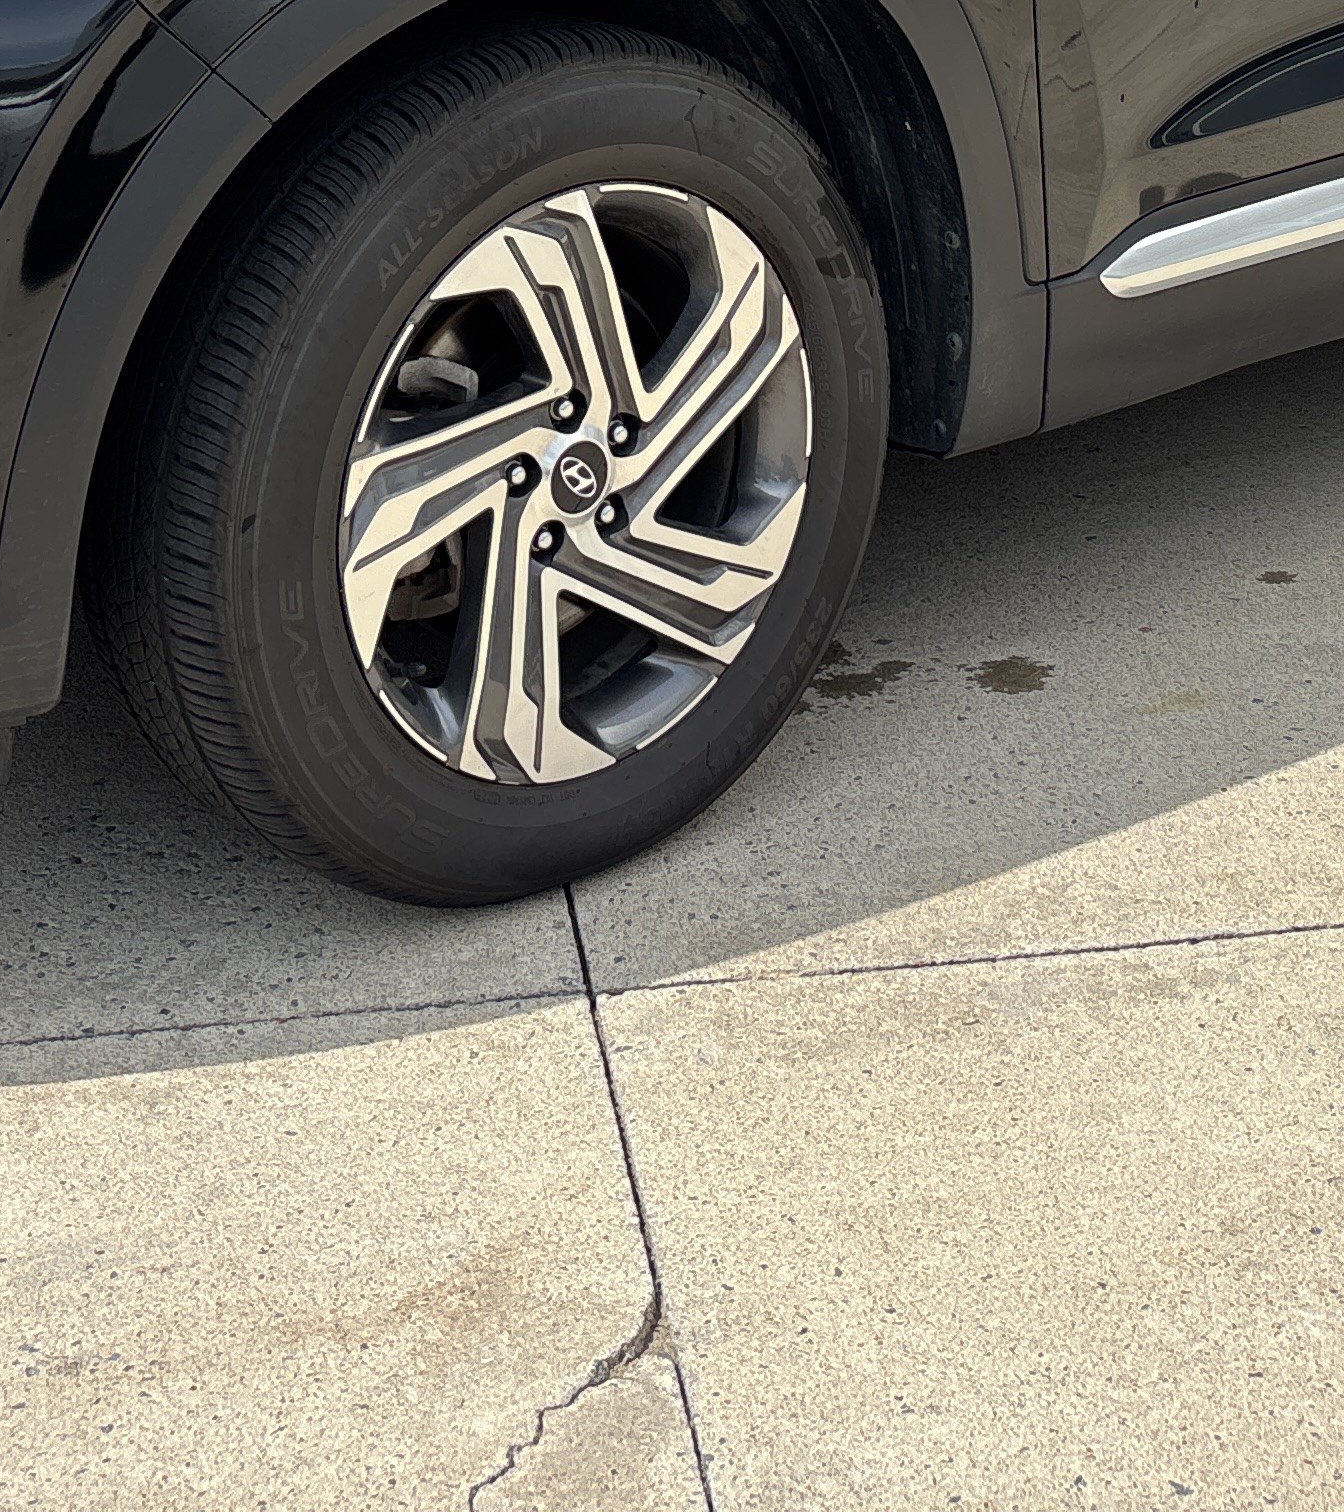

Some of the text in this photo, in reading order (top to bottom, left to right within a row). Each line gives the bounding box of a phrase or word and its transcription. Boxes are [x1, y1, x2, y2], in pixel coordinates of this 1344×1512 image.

[367, 122, 544, 292] ALL-SEASON
[744, 134, 874, 410] SUREDRIVE
[274, 571, 452, 860] SUREDRIVE
